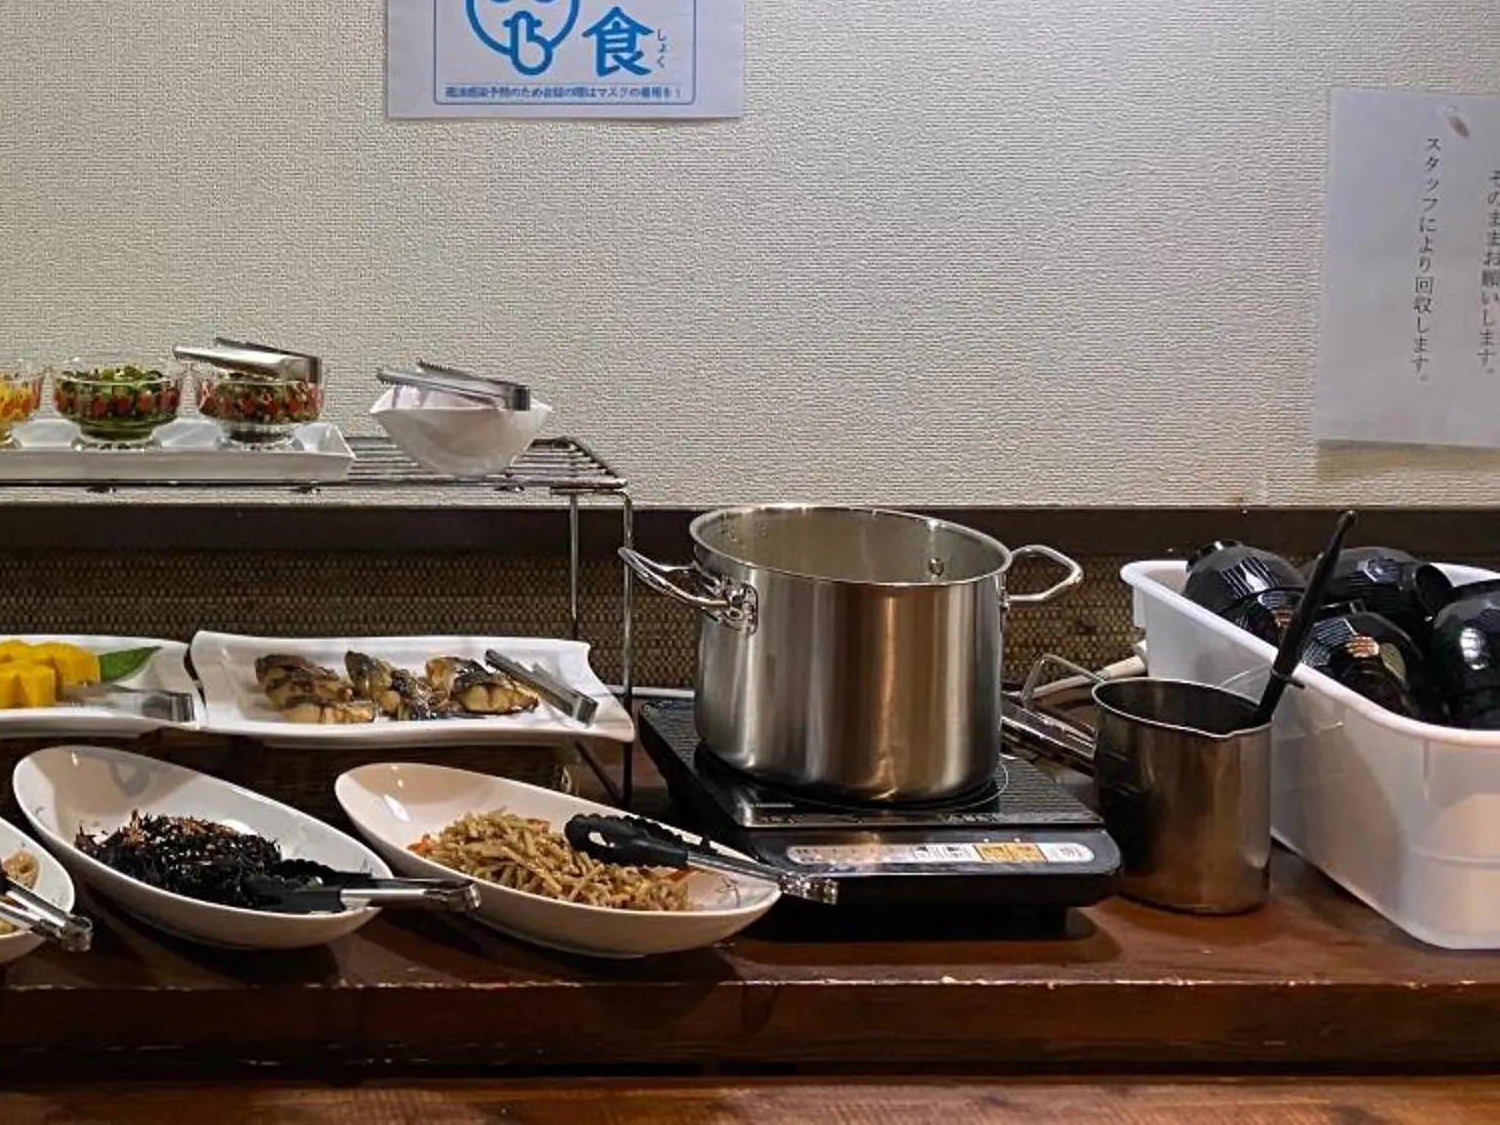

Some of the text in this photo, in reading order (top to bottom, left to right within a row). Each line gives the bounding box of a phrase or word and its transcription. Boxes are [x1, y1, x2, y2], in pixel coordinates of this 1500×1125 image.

[1411, 137, 1442, 382] スタッフにより回収します。
